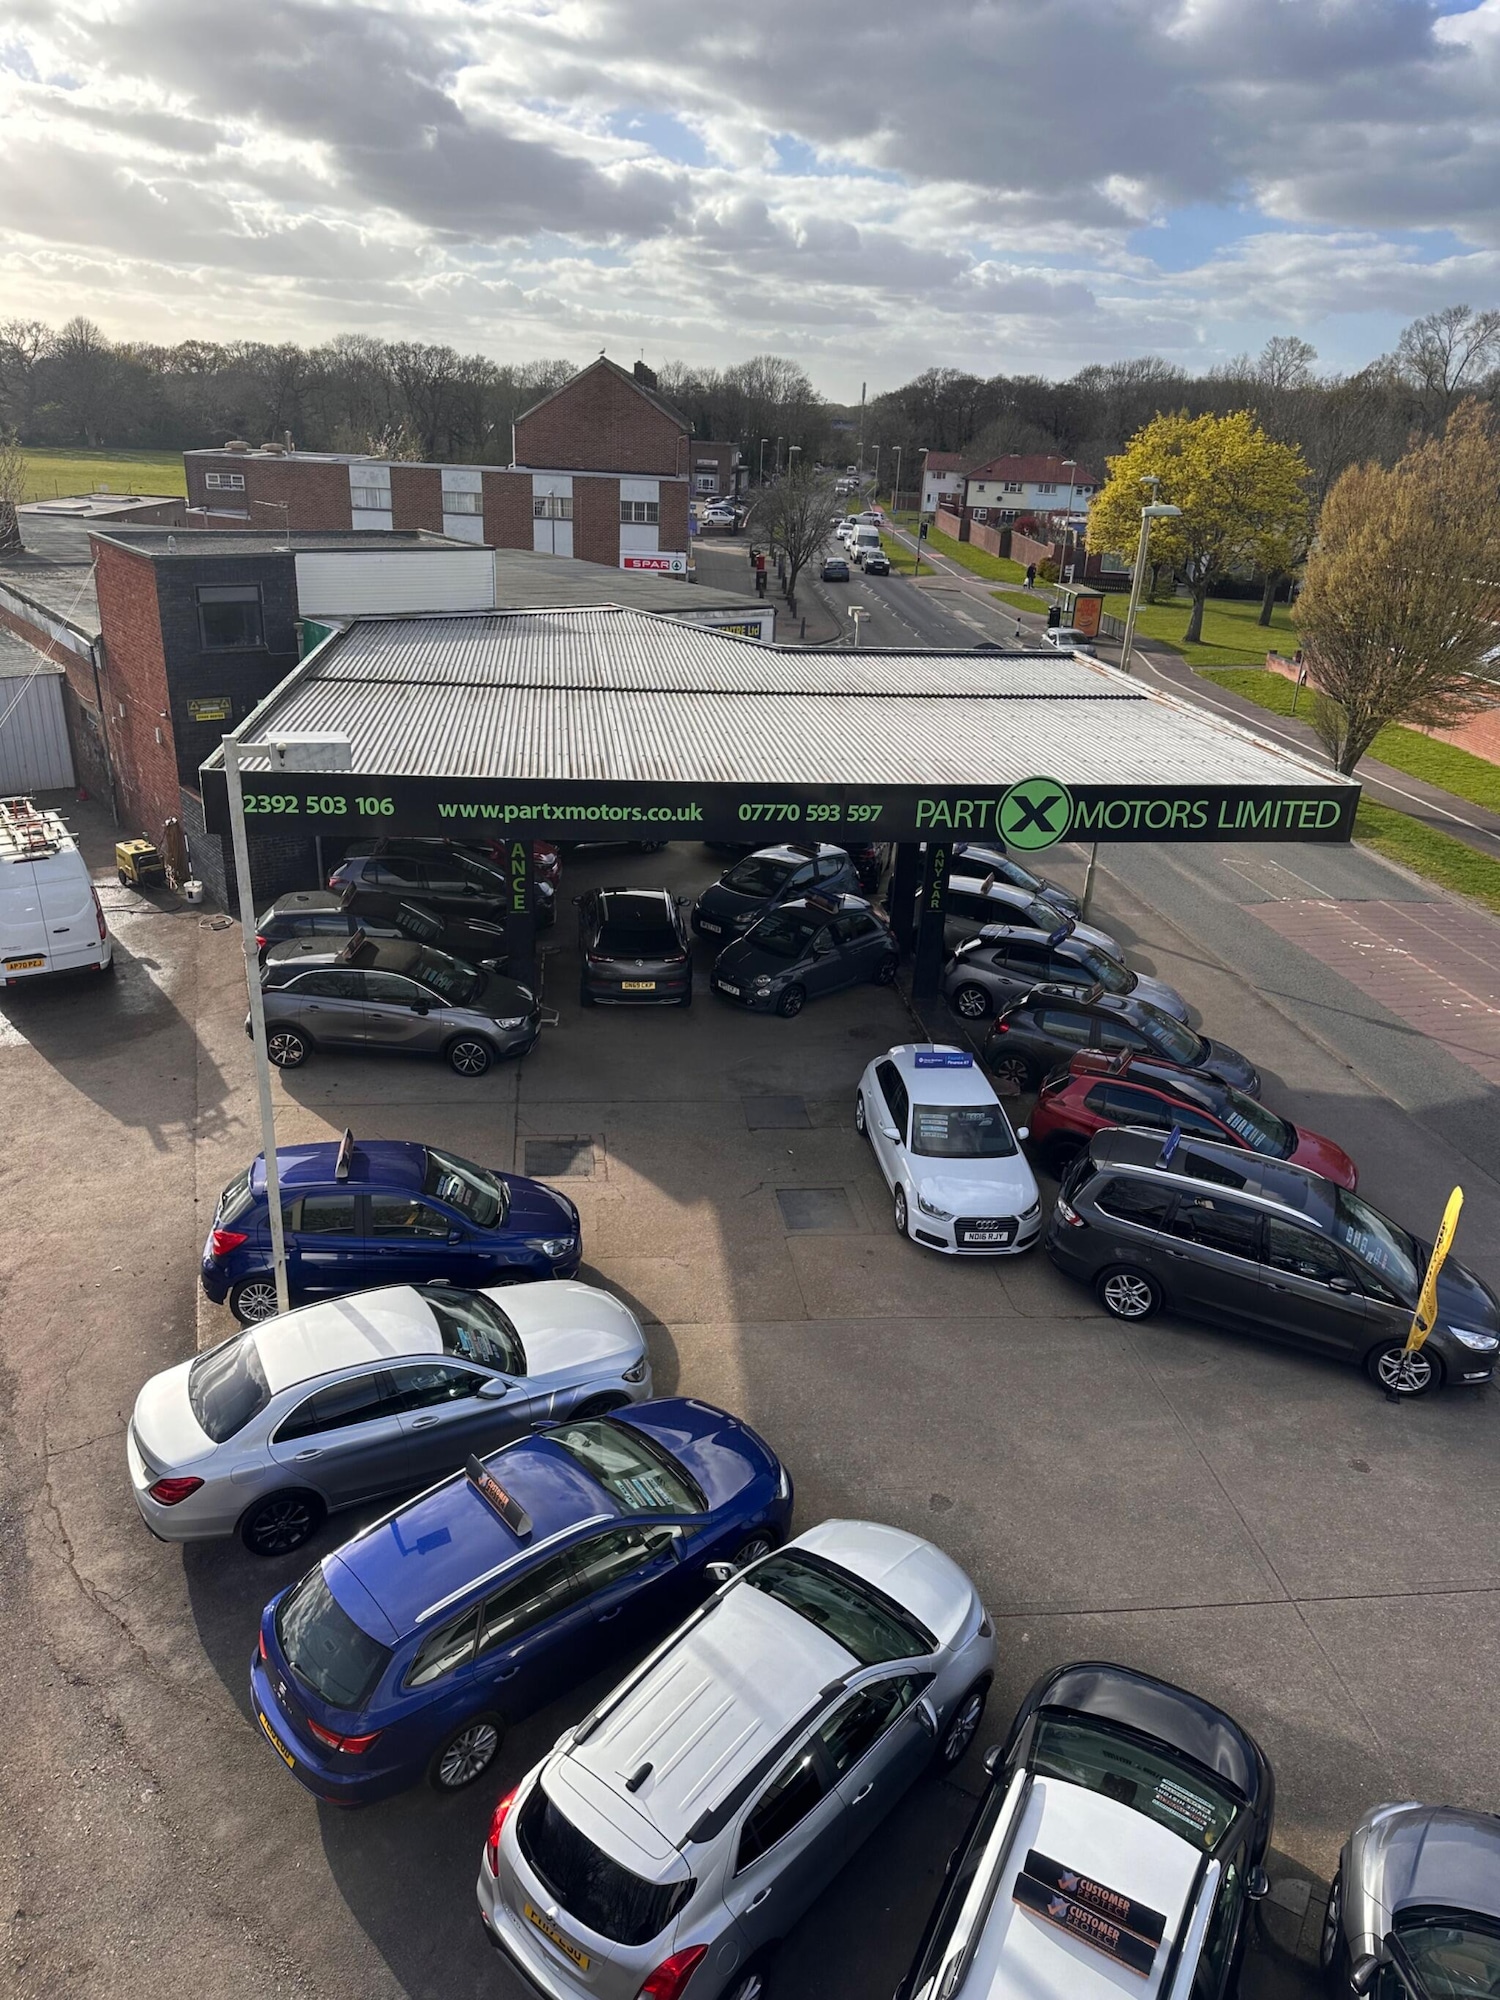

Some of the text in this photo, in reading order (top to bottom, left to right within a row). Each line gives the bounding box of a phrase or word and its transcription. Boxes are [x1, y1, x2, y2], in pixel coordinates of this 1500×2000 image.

[632, 559, 670, 569] SPAR
[747, 624, 760, 636] Ltd
[243, 794, 395, 816] 2392 503 106
[438, 802, 704, 824] www.partxmotors.co.uk
[738, 803, 883, 823] 07770 593 597
[915, 795, 1341, 833] PART X MOTORS LIMITED
[934, 849, 945, 878] ANY
[930, 880, 943, 908] CAR
[1153, 1785, 1217, 1824] SERVICE HISTORY
[1077, 1887, 1129, 1919] PROTECT
[1079, 1879, 1131, 1912] CUSTOMER
[1066, 1915, 1118, 1948] PROTECT
[1069, 1905, 1121, 1941] CUSTOMER
